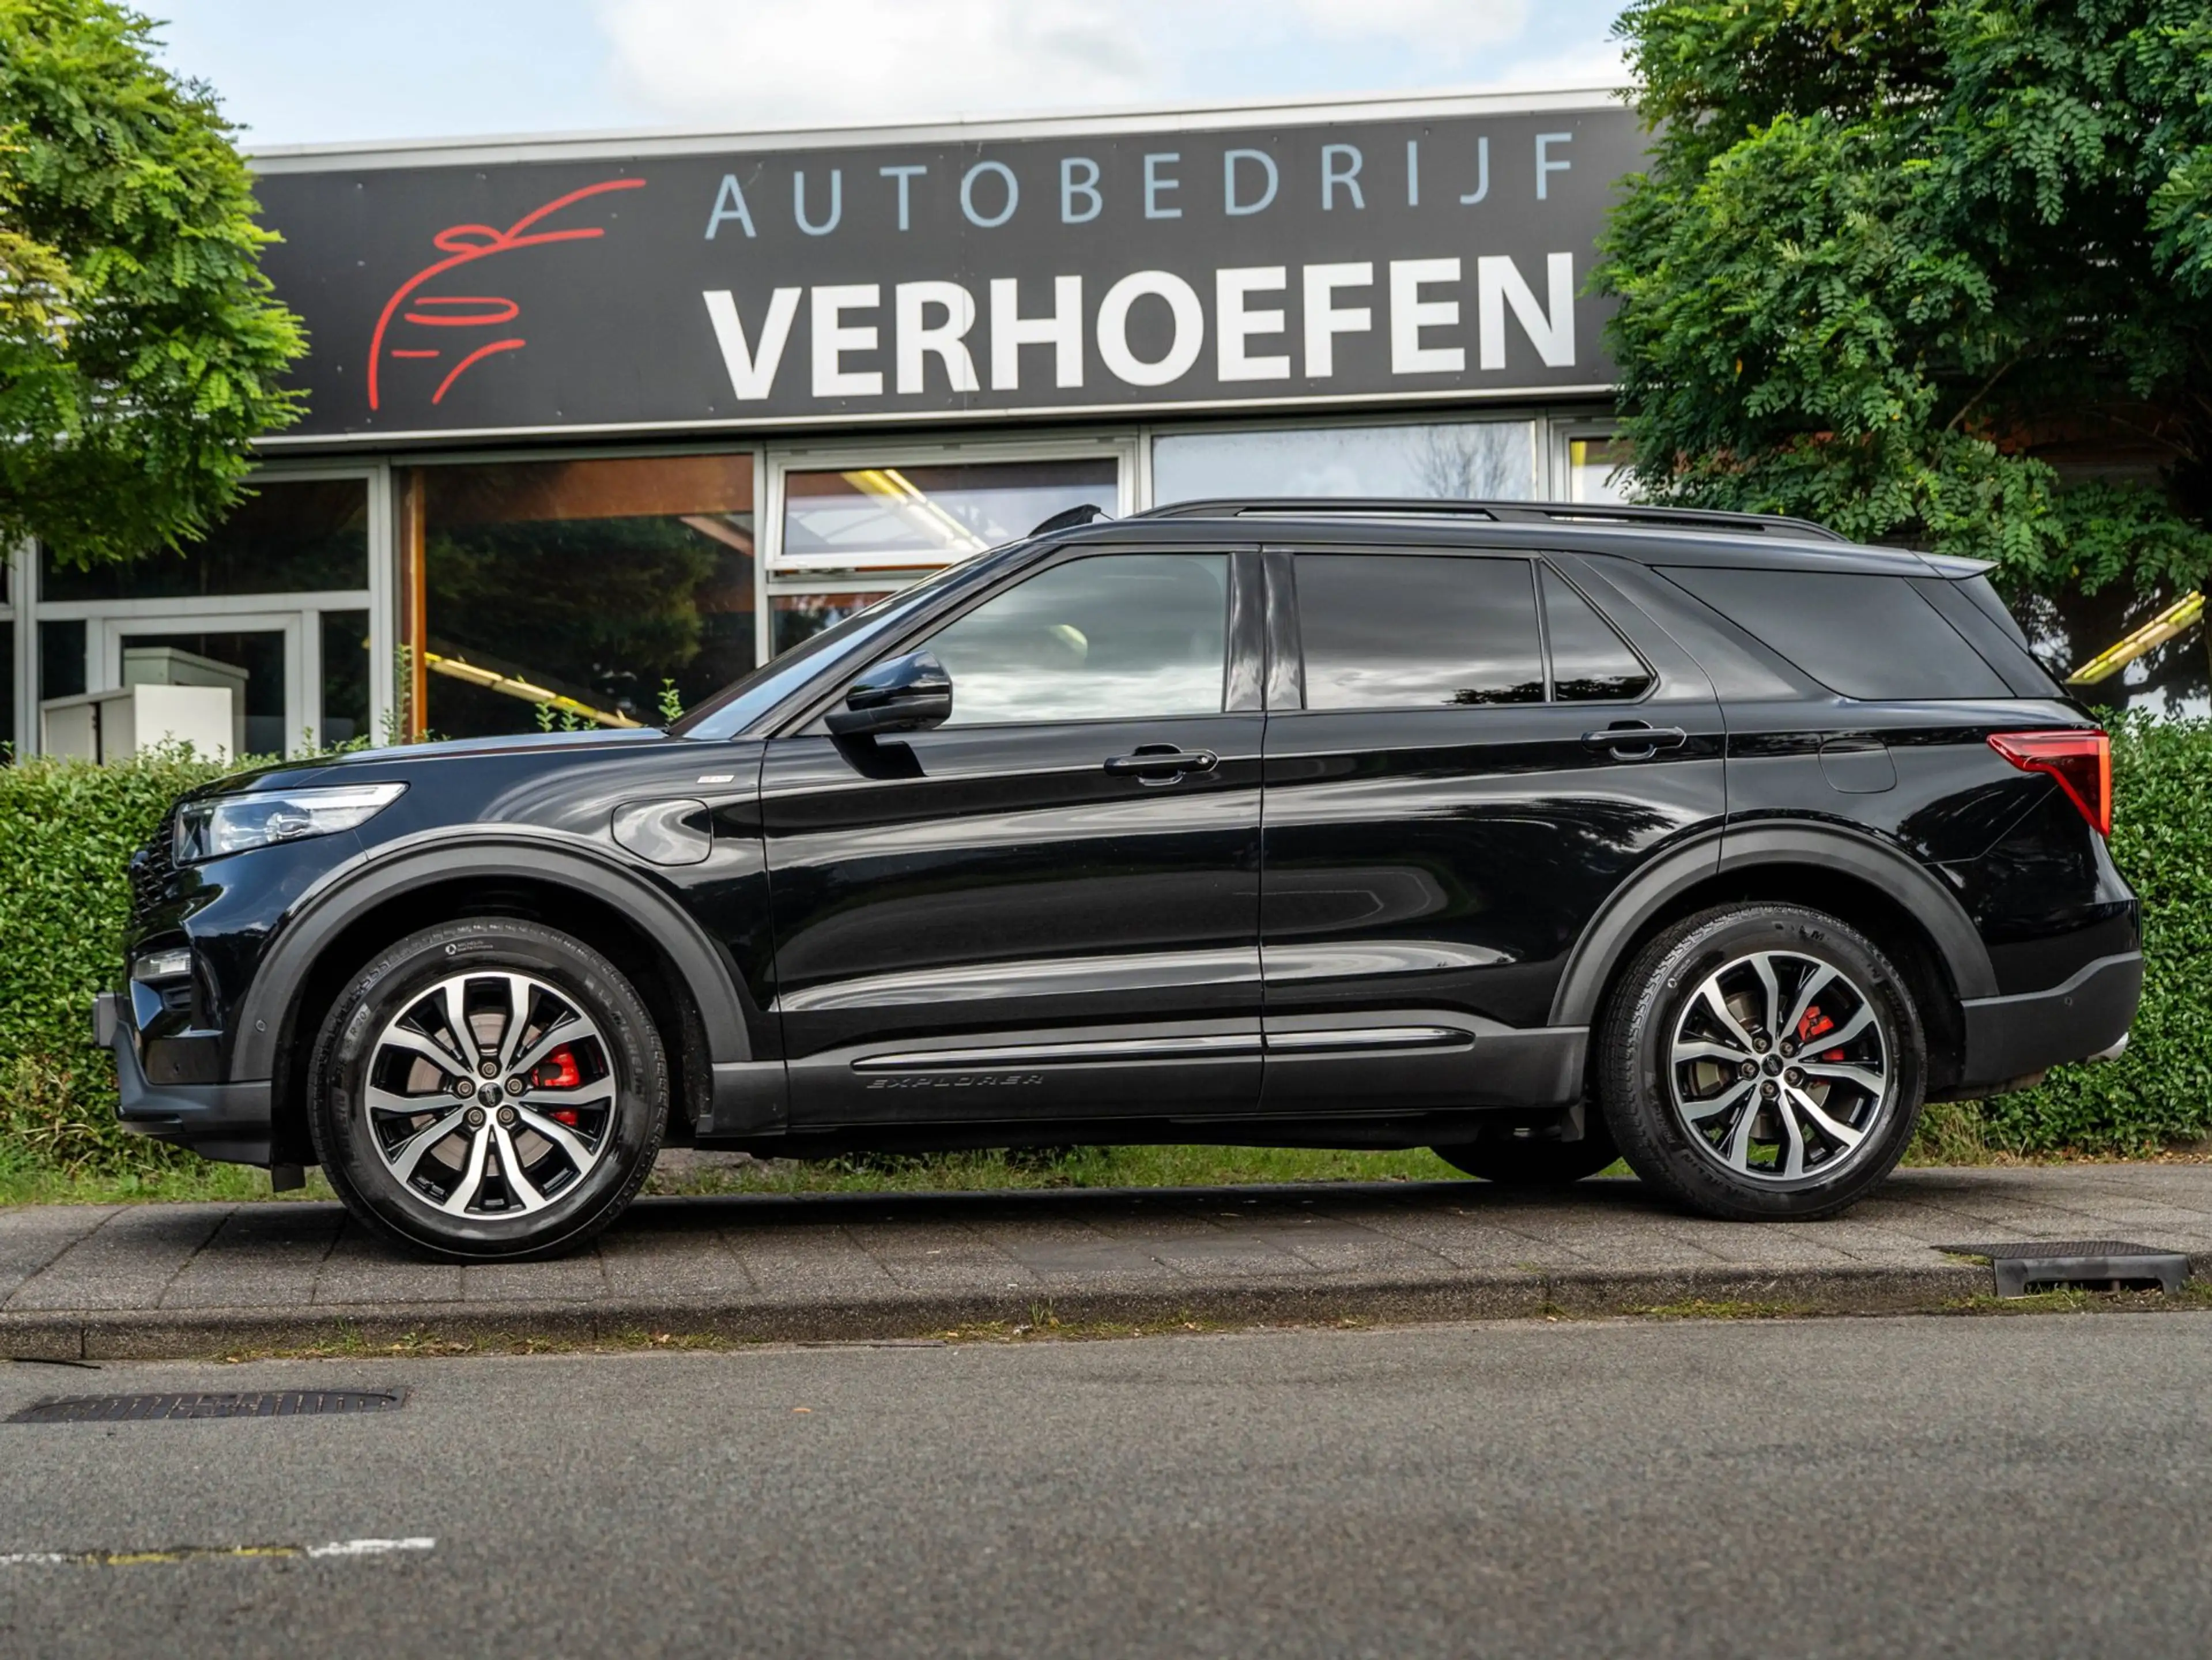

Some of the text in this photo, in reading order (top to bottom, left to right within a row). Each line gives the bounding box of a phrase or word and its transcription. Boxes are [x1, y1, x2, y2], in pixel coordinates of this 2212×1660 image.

[704, 132, 1574, 239] AUTOBEDRIJF
[703, 251, 1576, 401] VERHOEFEN
[866, 1075, 1044, 1089] EXPLORER
